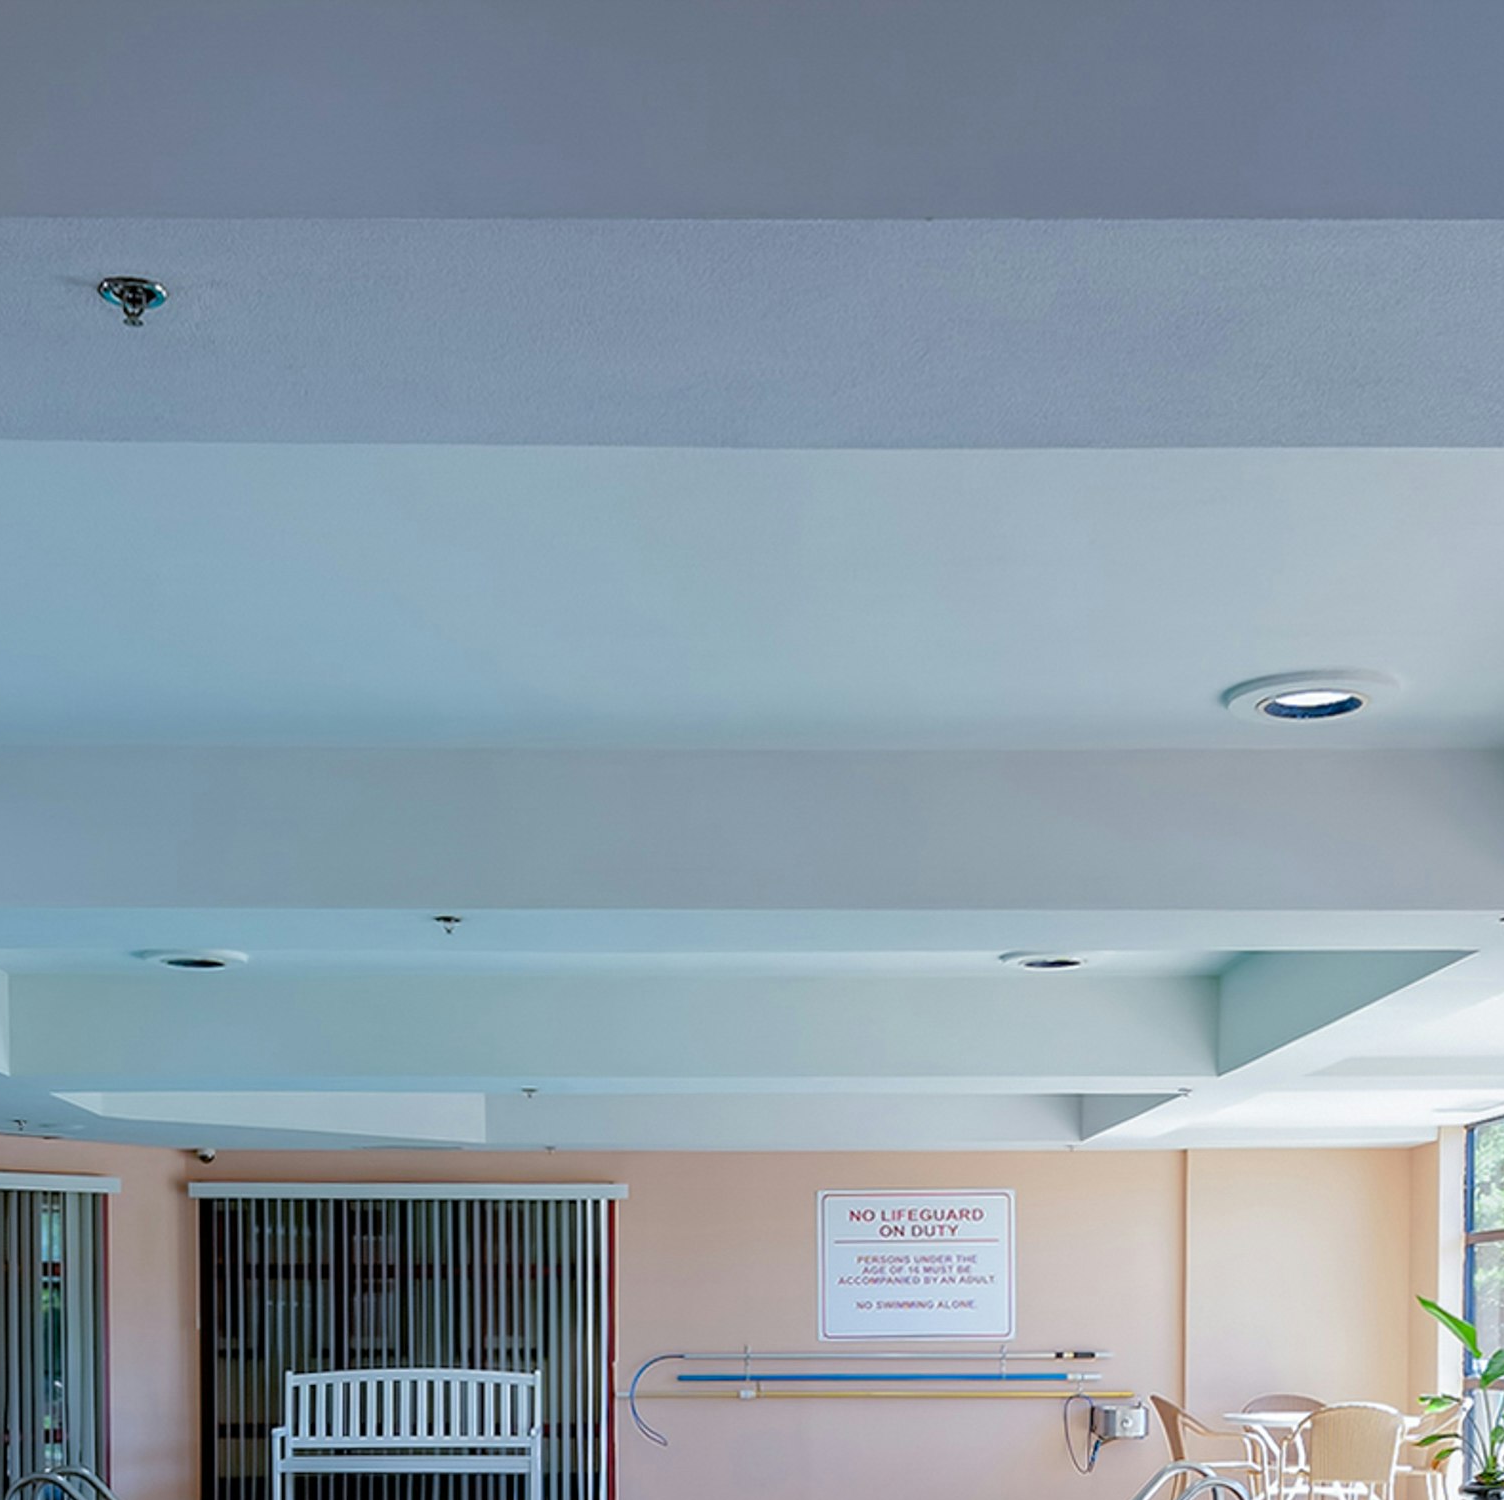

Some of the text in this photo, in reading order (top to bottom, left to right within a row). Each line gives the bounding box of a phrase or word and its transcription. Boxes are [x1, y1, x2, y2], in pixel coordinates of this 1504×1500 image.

[849, 1208, 984, 1222] NO LIFEGUARD
[879, 1224, 959, 1237] ON DUTY
[857, 1254, 977, 1264] PERSONS UNDER THE
[862, 1265, 884, 1274] AGE
[889, 1265, 903, 1274] OF
[923, 1265, 953, 1274] MUST
[957, 1265, 971, 1274] BE
[838, 1276, 921, 1285] ACCOMPANIED
[923, 1276, 939, 1285] BY
[939, 1276, 956, 1284] AN
[856, 1301, 873, 1310] NO
[876, 1300, 934, 1310] SWIMMING
